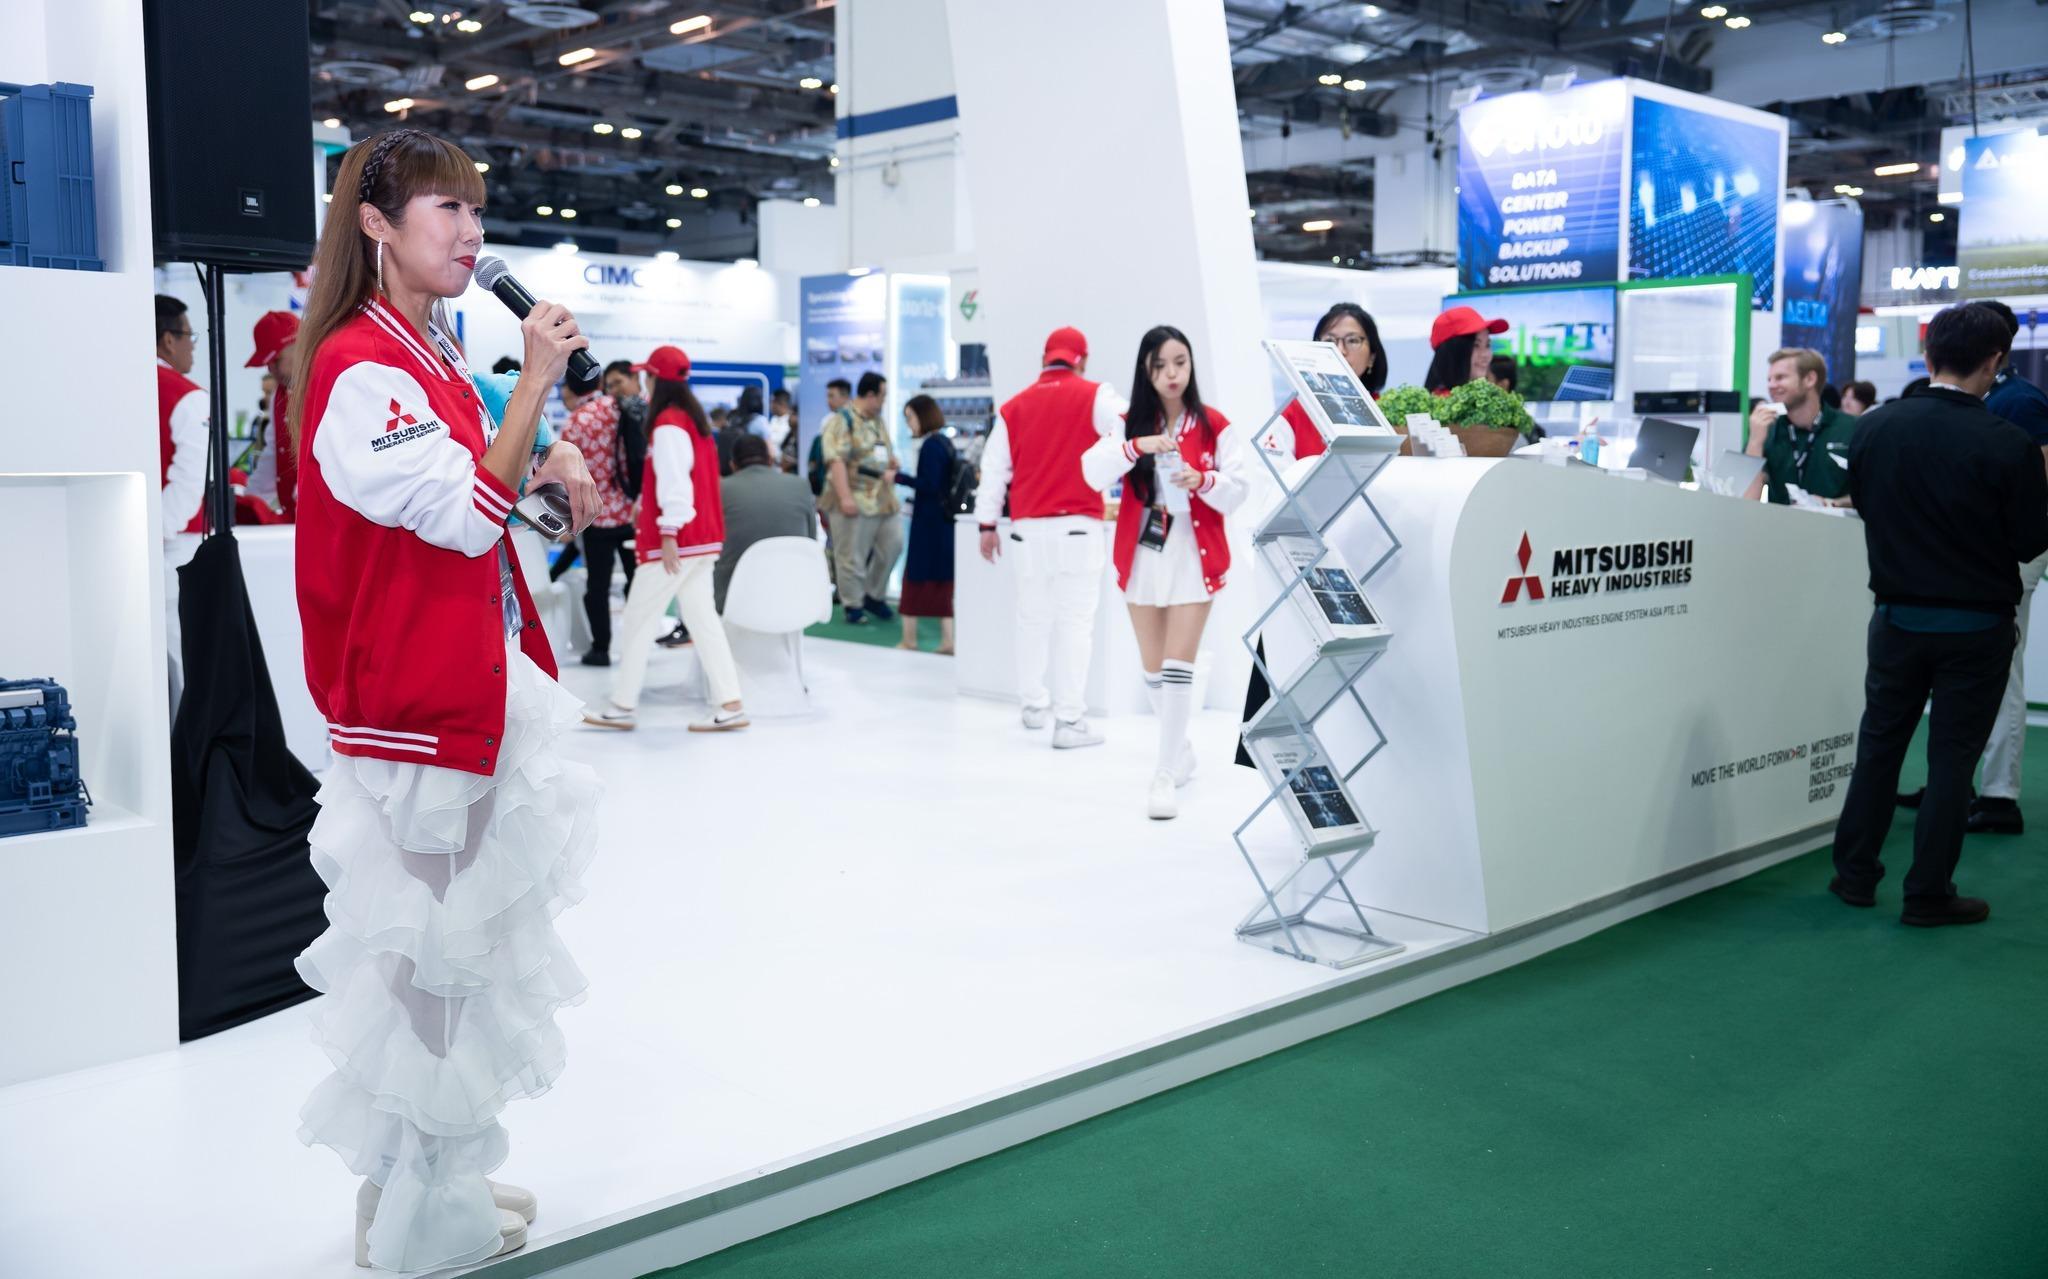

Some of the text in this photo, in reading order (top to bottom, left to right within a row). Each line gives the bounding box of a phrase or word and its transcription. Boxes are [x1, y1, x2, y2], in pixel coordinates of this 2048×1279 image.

[1511, 169, 1558, 190] DATA
[1501, 191, 1569, 214] CENTER
[1503, 215, 1565, 236] POWER
[1498, 238, 1569, 260] BACKUP
[1489, 260, 1583, 284] SOLUTIONS
[371, 420, 438, 447] MITSUBISHI
[373, 426, 441, 452] GENERATOR SERIES
[1552, 540, 1693, 577] MITSUBISHI
[1551, 567, 1692, 598] HEAVY INDUSTRIES
[1498, 624, 1537, 640] MITSUBISHI
[1539, 621, 1561, 634] HEAVY
[1562, 615, 1600, 630] INDUSTRIES
[1601, 611, 1623, 624] ENGINE
[1625, 608, 1648, 620] SYSTEM
[1649, 606, 1662, 617] ASIA
[1663, 605, 1676, 616] PTE.
[1810, 732, 1854, 753] MITSUBISHI
[1691, 767, 1716, 788] MOVE
[1718, 762, 1735, 780] THE
[1736, 755, 1767, 776] WORLD
[1809, 762, 1854, 787] INDUSTRIES
[1810, 753, 1835, 772] HEAVY
[1808, 783, 1835, 803] GROUP
